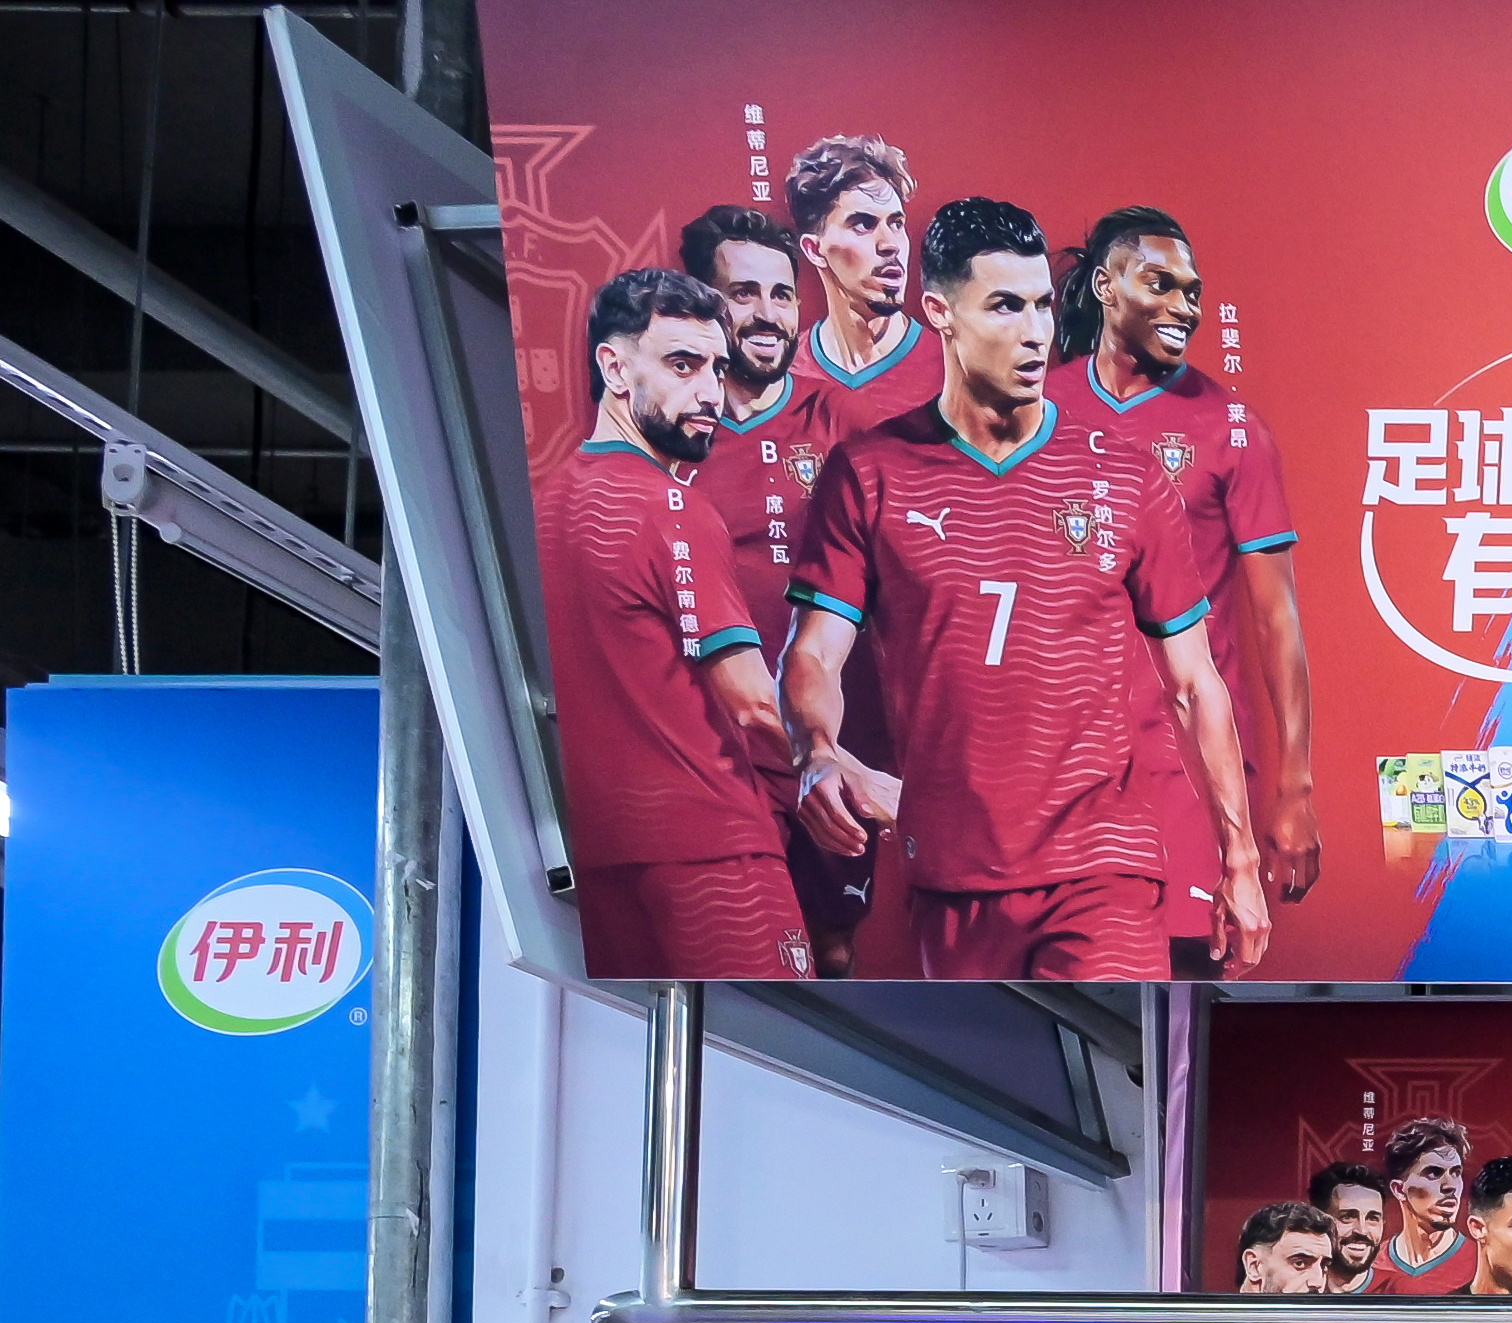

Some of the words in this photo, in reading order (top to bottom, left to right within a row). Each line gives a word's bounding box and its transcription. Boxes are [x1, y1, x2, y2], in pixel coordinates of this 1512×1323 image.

[744, 104, 772, 202] 维蒂尼亚
[1218, 303, 1248, 448] 拉斐尔·莱昂
[978, 582, 1017, 666] 7
[191, 920, 341, 984] 伊利
